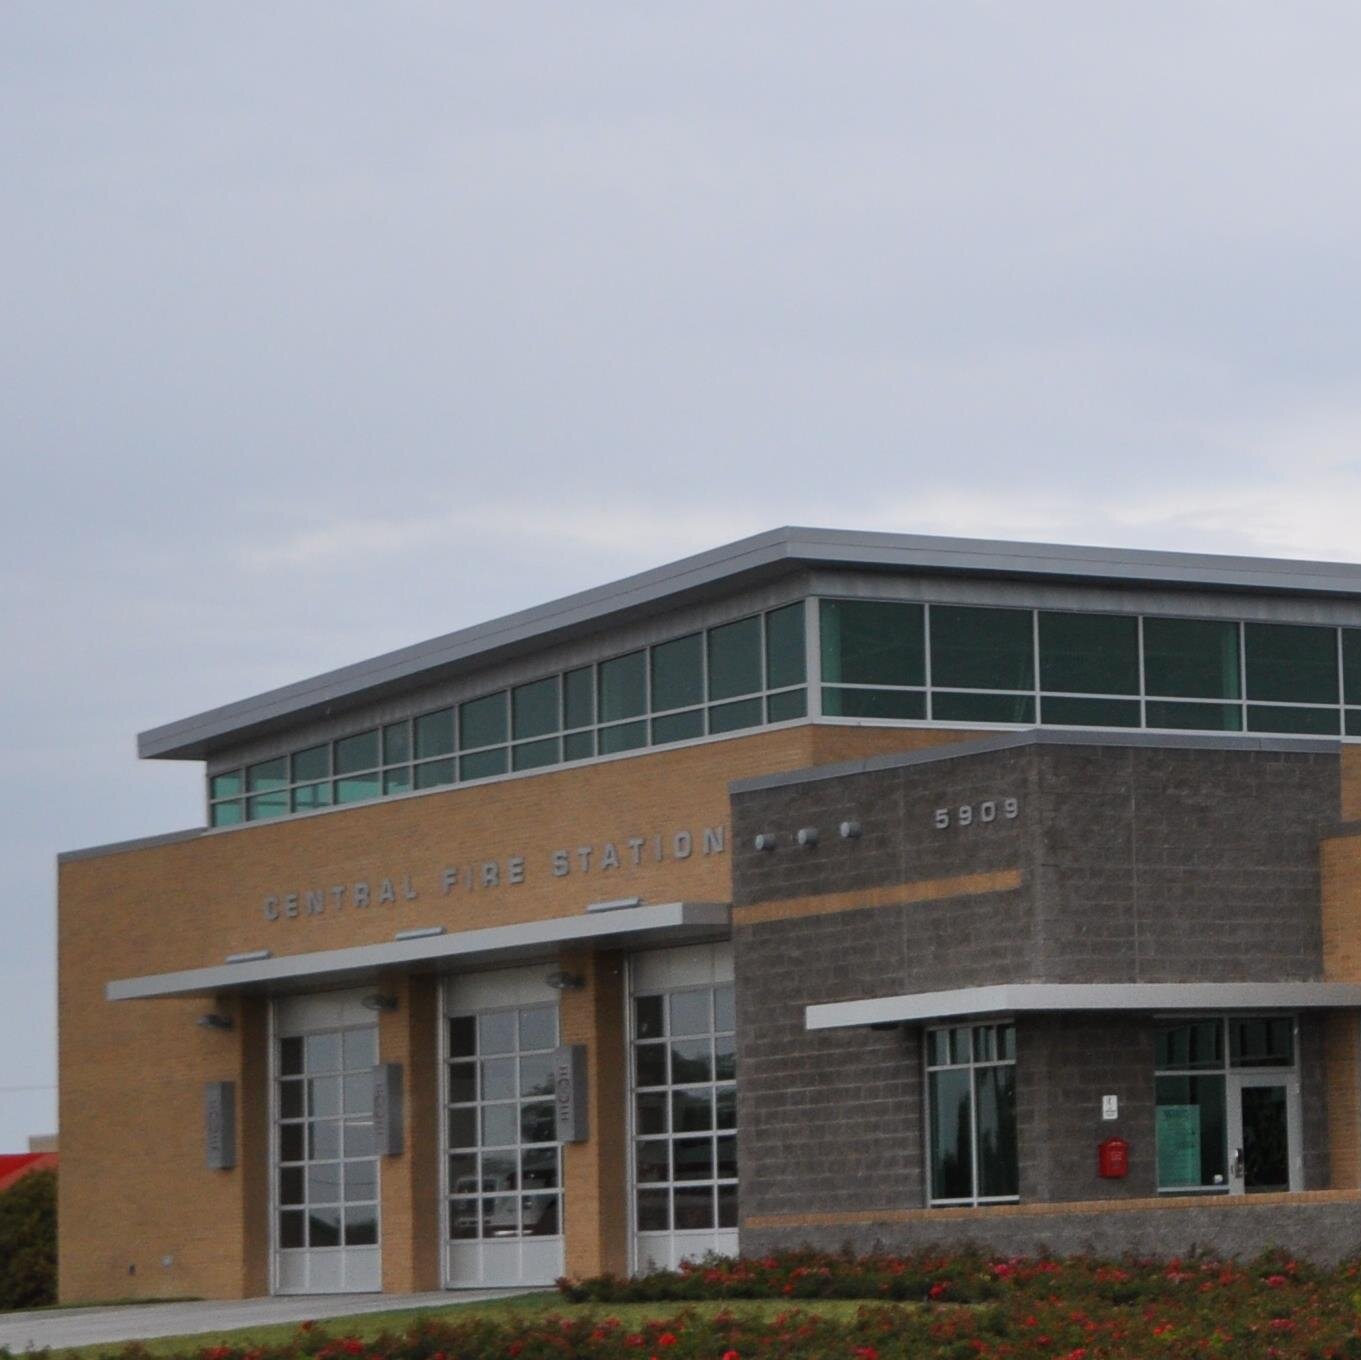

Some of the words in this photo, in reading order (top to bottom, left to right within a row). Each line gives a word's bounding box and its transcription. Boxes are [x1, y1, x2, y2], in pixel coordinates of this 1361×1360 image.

[935, 798, 1018, 829] 5909
[264, 872, 417, 921] CENTRAL
[442, 855, 526, 896] FIRE
[551, 825, 726, 877] STATION
